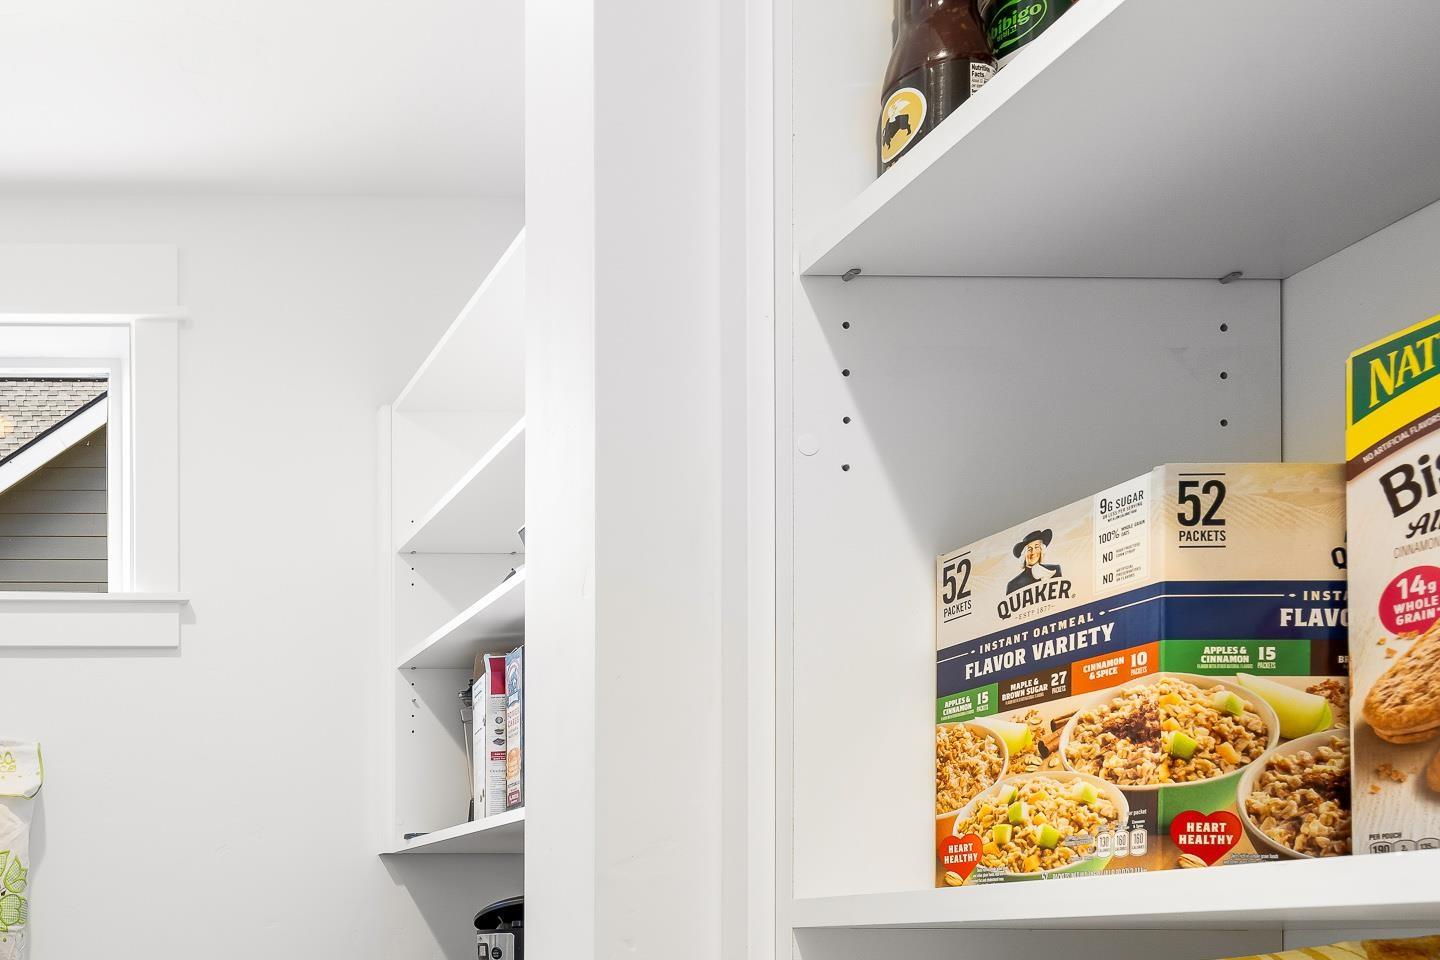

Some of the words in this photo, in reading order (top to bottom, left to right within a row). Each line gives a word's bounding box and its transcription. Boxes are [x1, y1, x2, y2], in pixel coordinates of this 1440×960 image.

[1362, 453, 1374, 464] NO
[1374, 430, 1410, 457] ARTIFICIAL
[1410, 413, 1440, 434] FLAVORS
[1116, 490, 1144, 509] SUGAR
[1177, 480, 1226, 527] 52
[1099, 528, 1120, 544] 100%
[1179, 530, 1226, 541] PACKETS
[1102, 552, 1113, 563] NO
[942, 558, 971, 605] 52
[1102, 573, 1113, 584] NO
[1396, 574, 1437, 600] 14g
[997, 579, 1072, 621] QUAKER
[1393, 594, 1439, 615] WHOLE
[943, 599, 972, 618] PACKETS
[979, 631, 1029, 655] INSTANT
[1033, 613, 1094, 638] OATMEAL
[965, 649, 1026, 680] FLAVOR
[1032, 623, 1115, 661] VARIETY
[1203, 647, 1238, 655] APPLES
[1240, 647, 1247, 655] &
[1258, 647, 1276, 661] 15
[1083, 656, 1125, 674] CINNAMON
[1130, 651, 1148, 668] 10
[1201, 655, 1249, 663] CINNAMON
[1051, 672, 1067, 686] 27
[1095, 667, 1118, 679] SPICE
[1010, 680, 1032, 691] MAPLE
[1033, 678, 1039, 686] &
[976, 691, 989, 705] 15
[1001, 688, 1024, 701] BROWN
[1026, 683, 1048, 696] SUGAR
[944, 697, 965, 708] APPLES
[943, 704, 972, 716] CINNAMON
[1186, 822, 1227, 833] HEART
[1179, 834, 1233, 845] HEALTHY
[948, 842, 973, 853] HEART
[944, 854, 978, 864] HEALTHY
